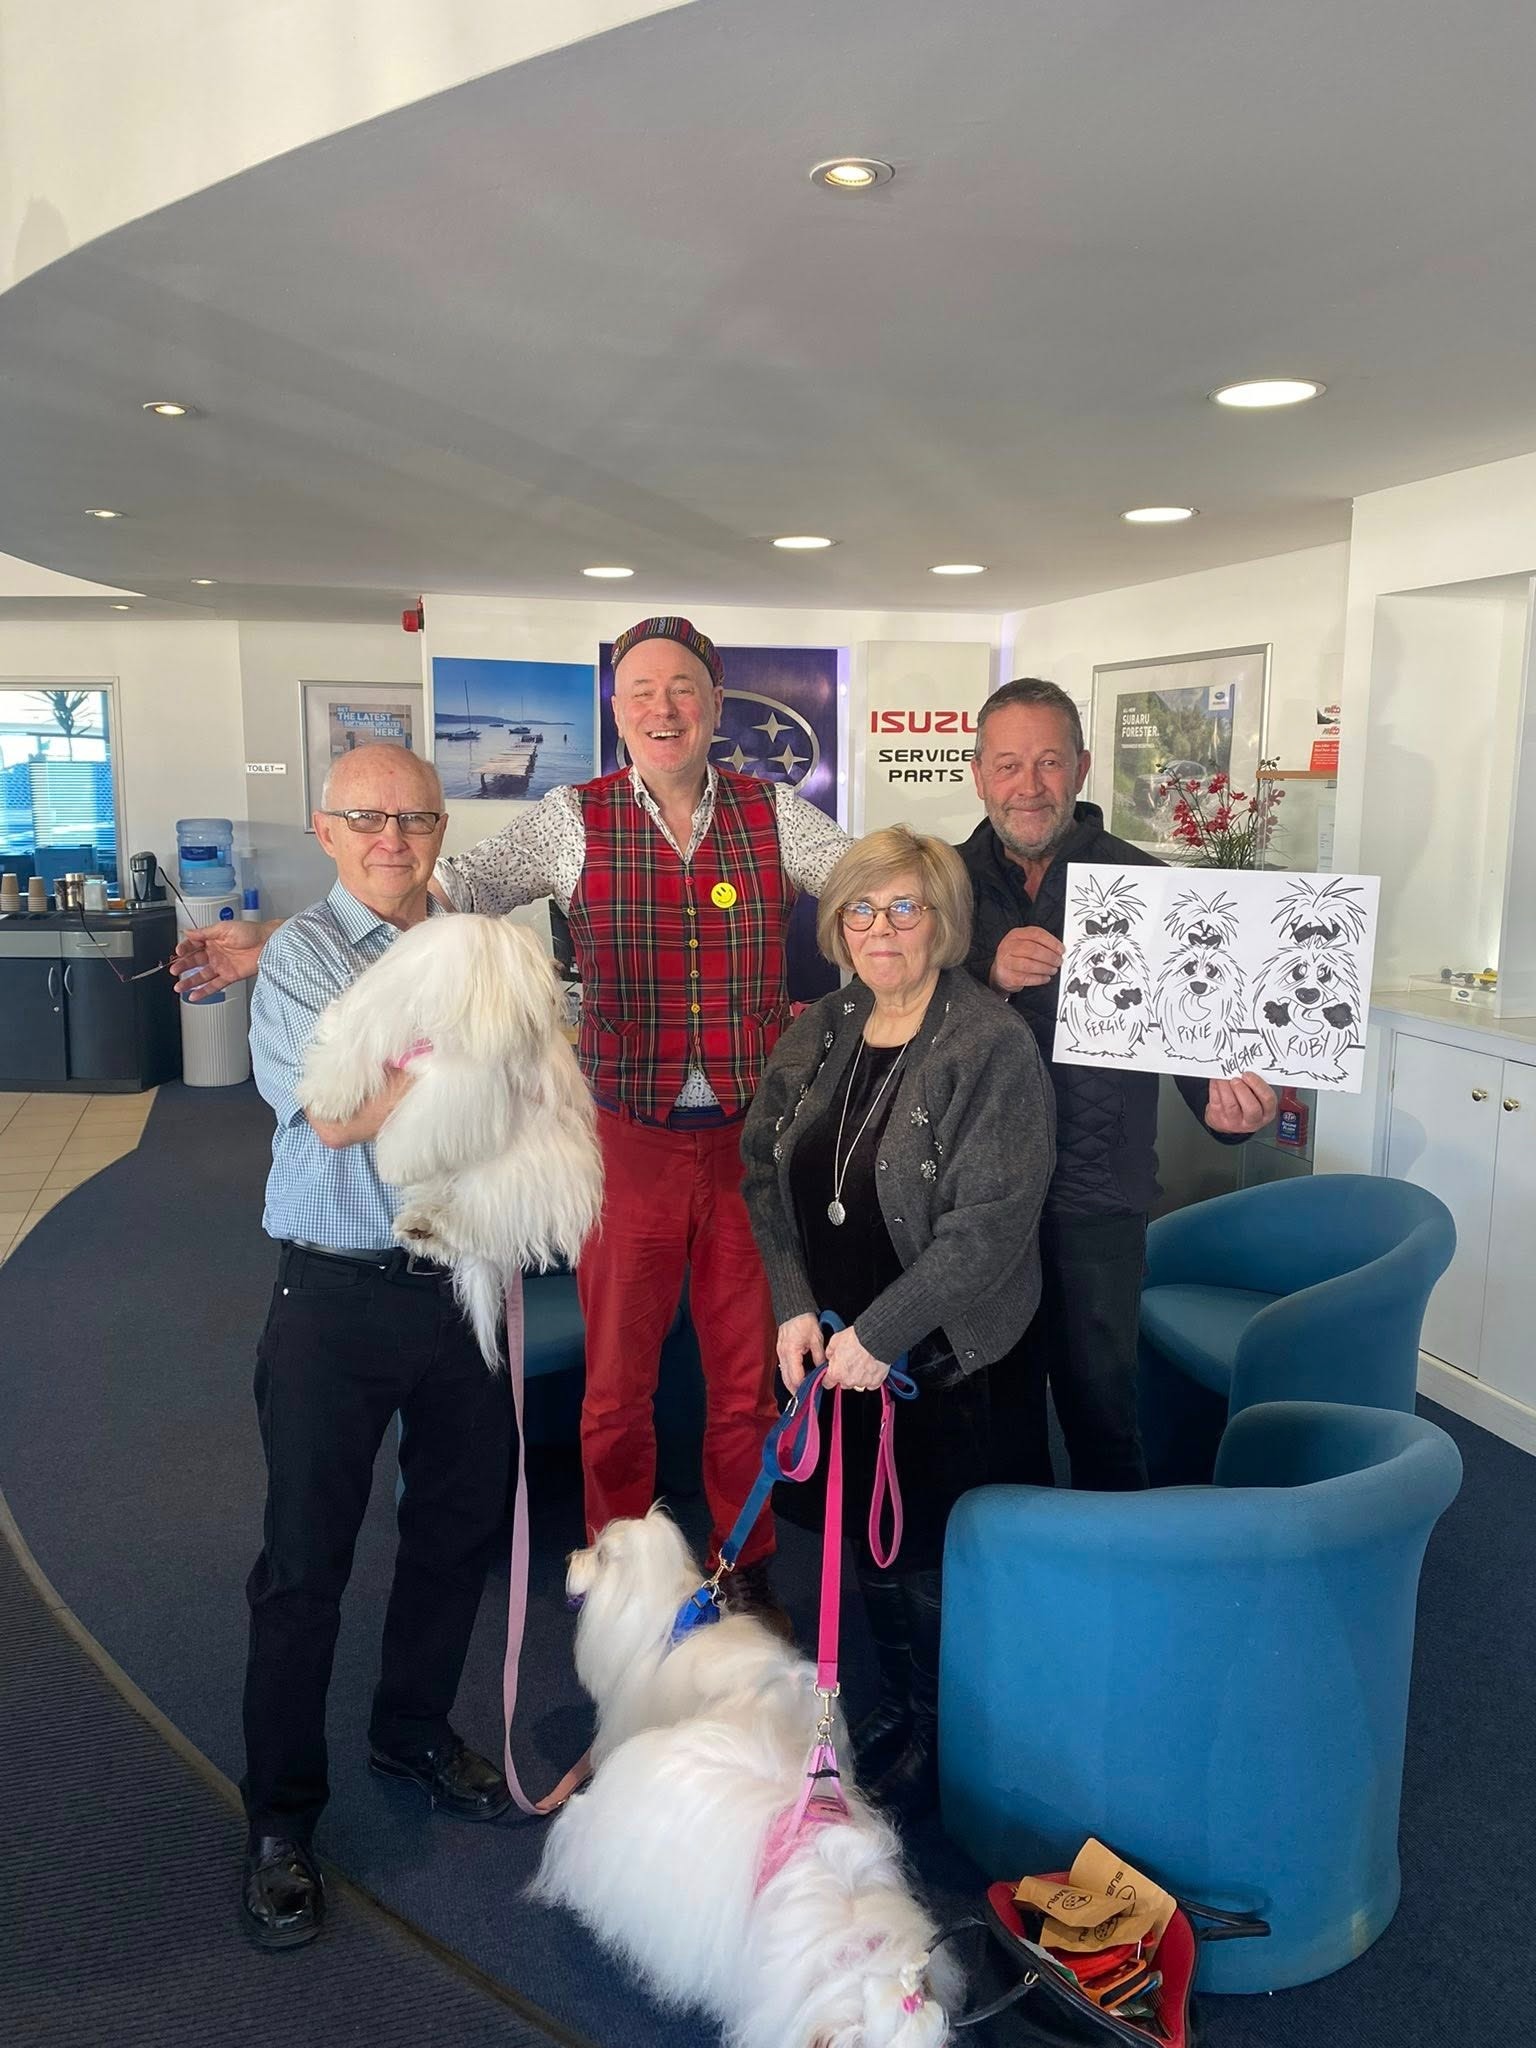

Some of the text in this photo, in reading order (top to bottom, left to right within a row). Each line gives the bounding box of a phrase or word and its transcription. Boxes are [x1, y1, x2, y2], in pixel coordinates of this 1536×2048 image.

[337, 712, 392, 721] THE LATEST
[1122, 714, 1150, 725] SUBARU
[375, 728, 402, 737] HERE.
[1121, 726, 1160, 738] FORESTER.
[879, 749, 974, 762] SERVICE
[248, 764, 274, 772] TOILET
[889, 769, 964, 782] PARTS
[1287, 1031, 1331, 1058] RUBY
[1105, 1871, 1124, 1897] SUB
